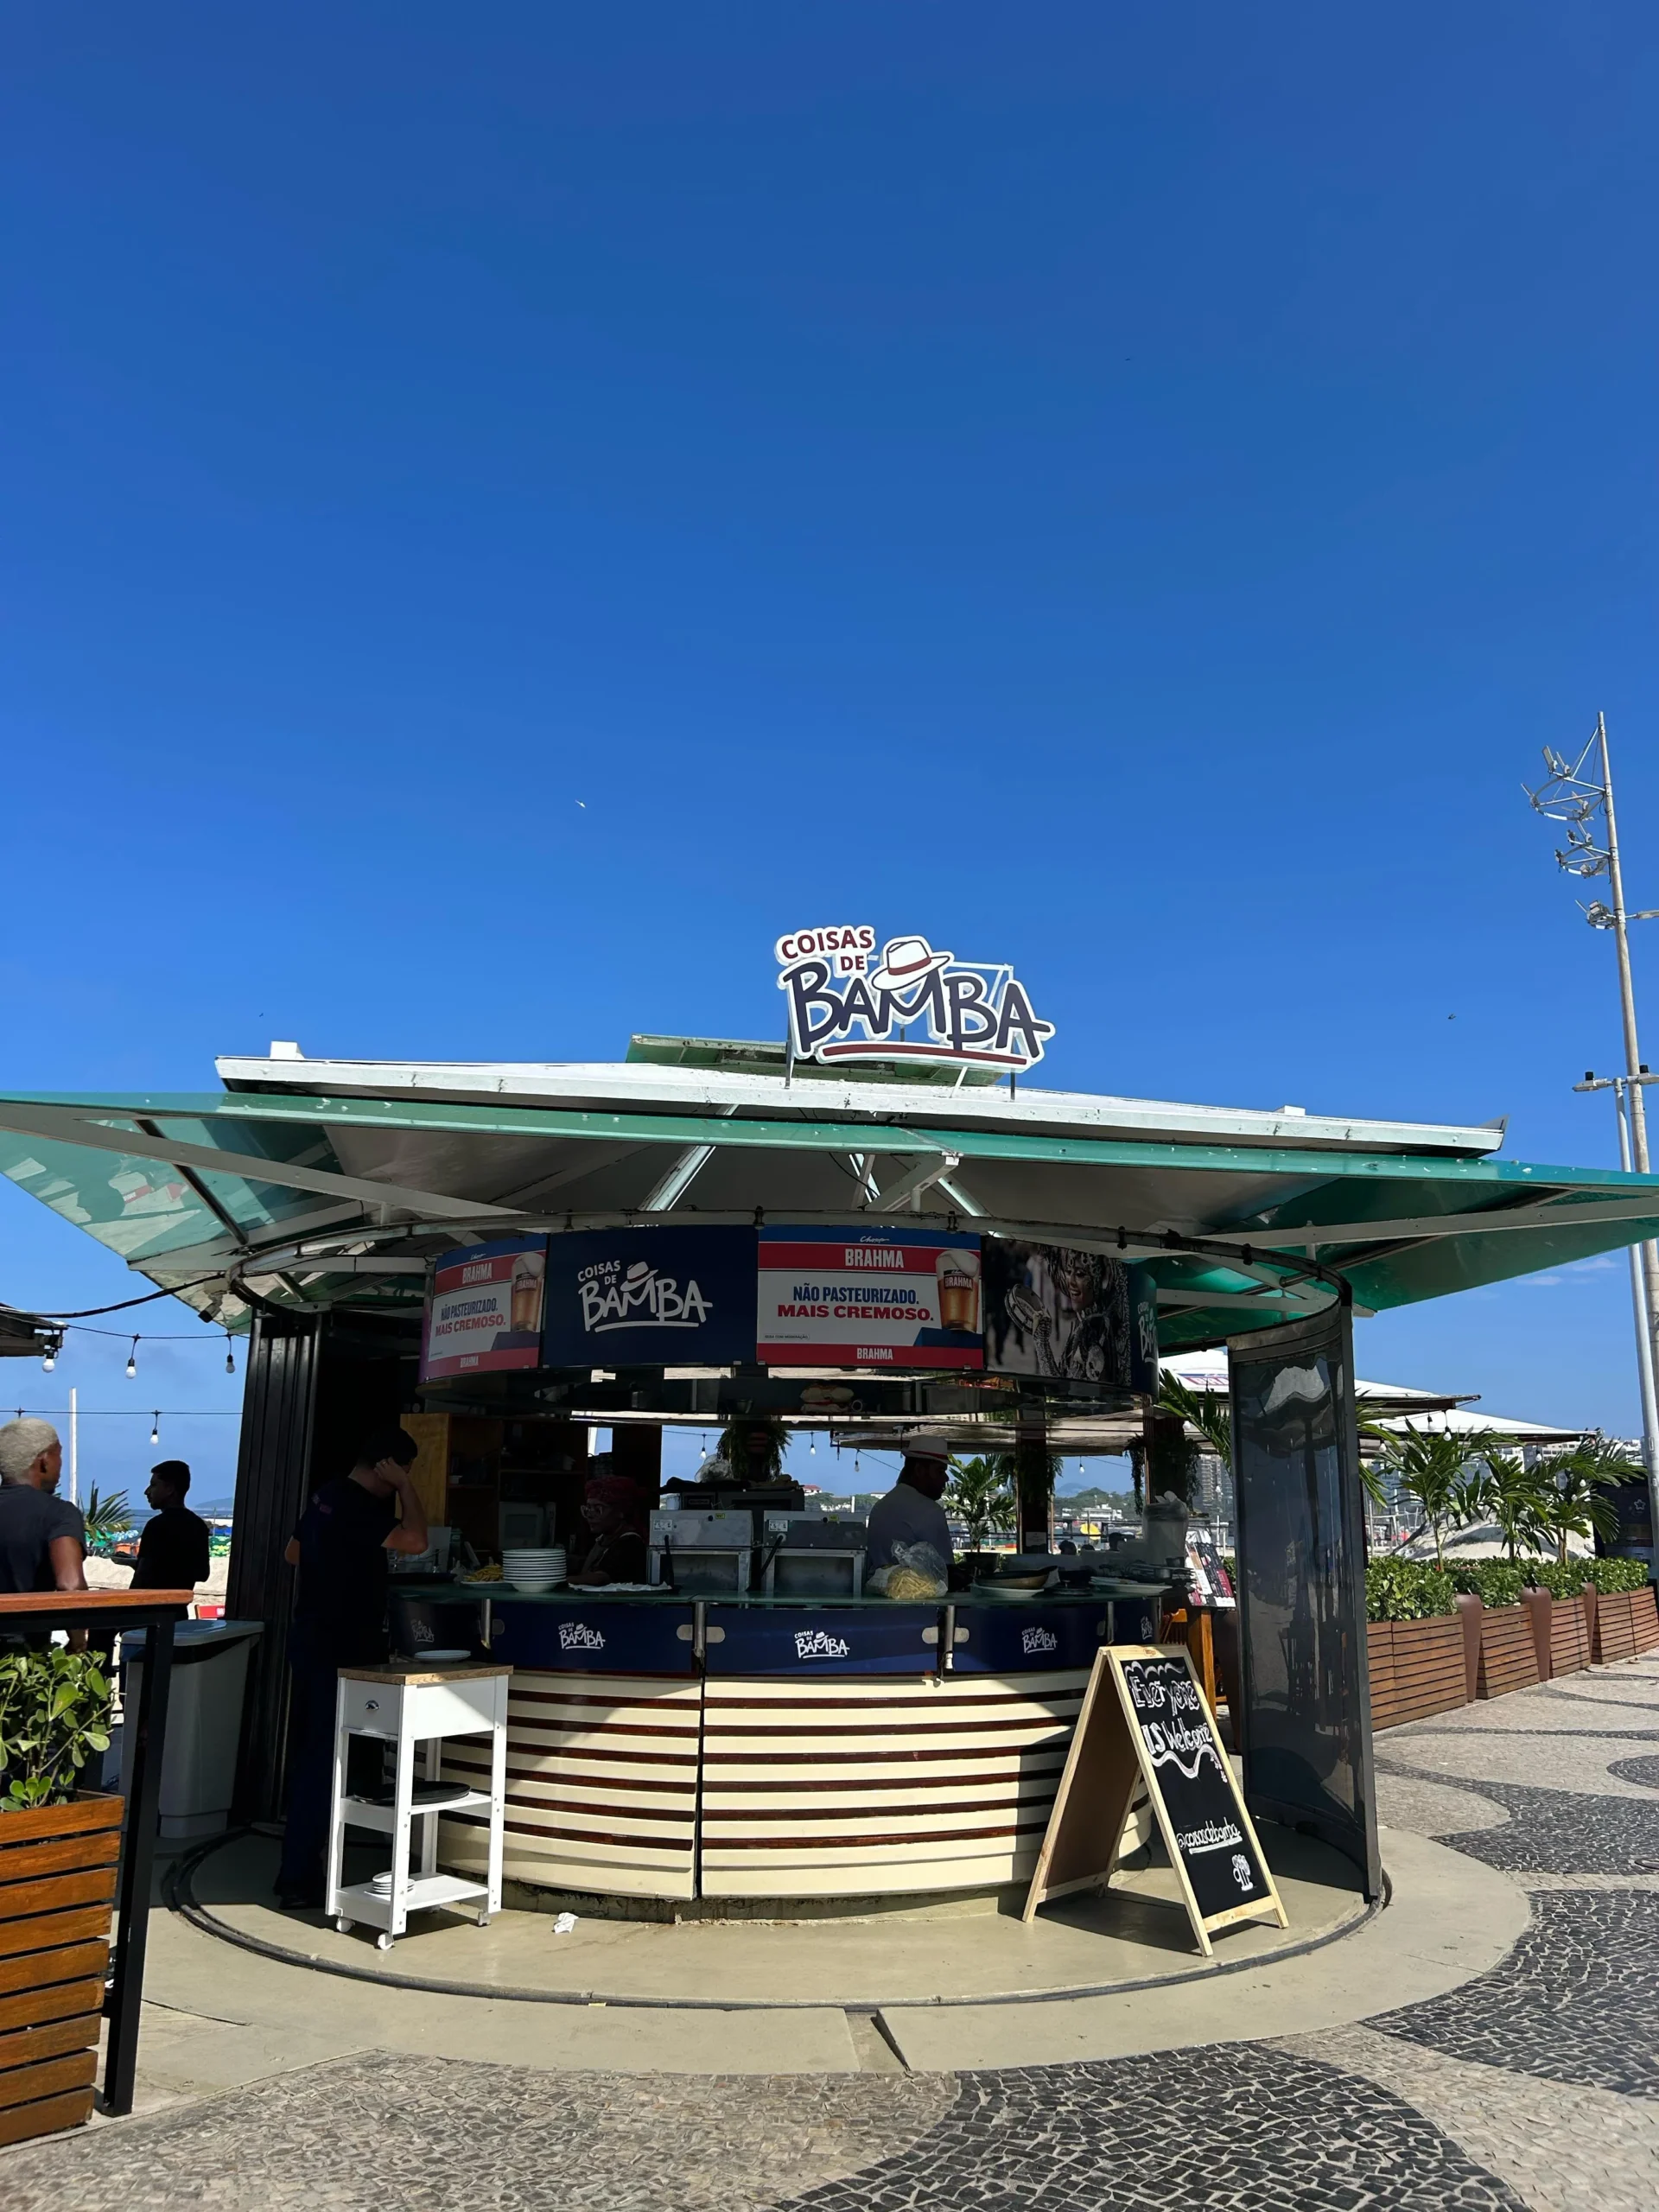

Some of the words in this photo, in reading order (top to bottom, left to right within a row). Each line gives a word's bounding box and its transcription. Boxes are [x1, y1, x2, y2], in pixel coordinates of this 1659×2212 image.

[781, 930, 873, 959] COISAS
[841, 956, 864, 971] DE
[783, 962, 1051, 1058] BAMBA
[845, 1248, 904, 1268] BRAHMA
[462, 1262, 493, 1285] BRAHMA
[577, 1260, 620, 1282] COISAS
[605, 1274, 617, 1285] DE
[944, 1276, 973, 1289] BRAHMA
[793, 1282, 820, 1302] NÃO
[823, 1287, 919, 1305] PASTEURIZADO.
[578, 1276, 714, 1332] BAMBA
[778, 1305, 830, 1318] MAIS
[833, 1306, 934, 1321] CREMOSO.
[435, 1321, 453, 1338] MAIS
[454, 1313, 507, 1332] CREMOSO.
[856, 1347, 893, 1360] BRAHMA
[559, 1630, 606, 1649] BAMBA
[794, 1630, 813, 1639] COISAS
[1021, 1633, 1058, 1653] BAMBA
[795, 1637, 850, 1658] BAMBA
[1160, 1717, 1212, 1753] Welcome
